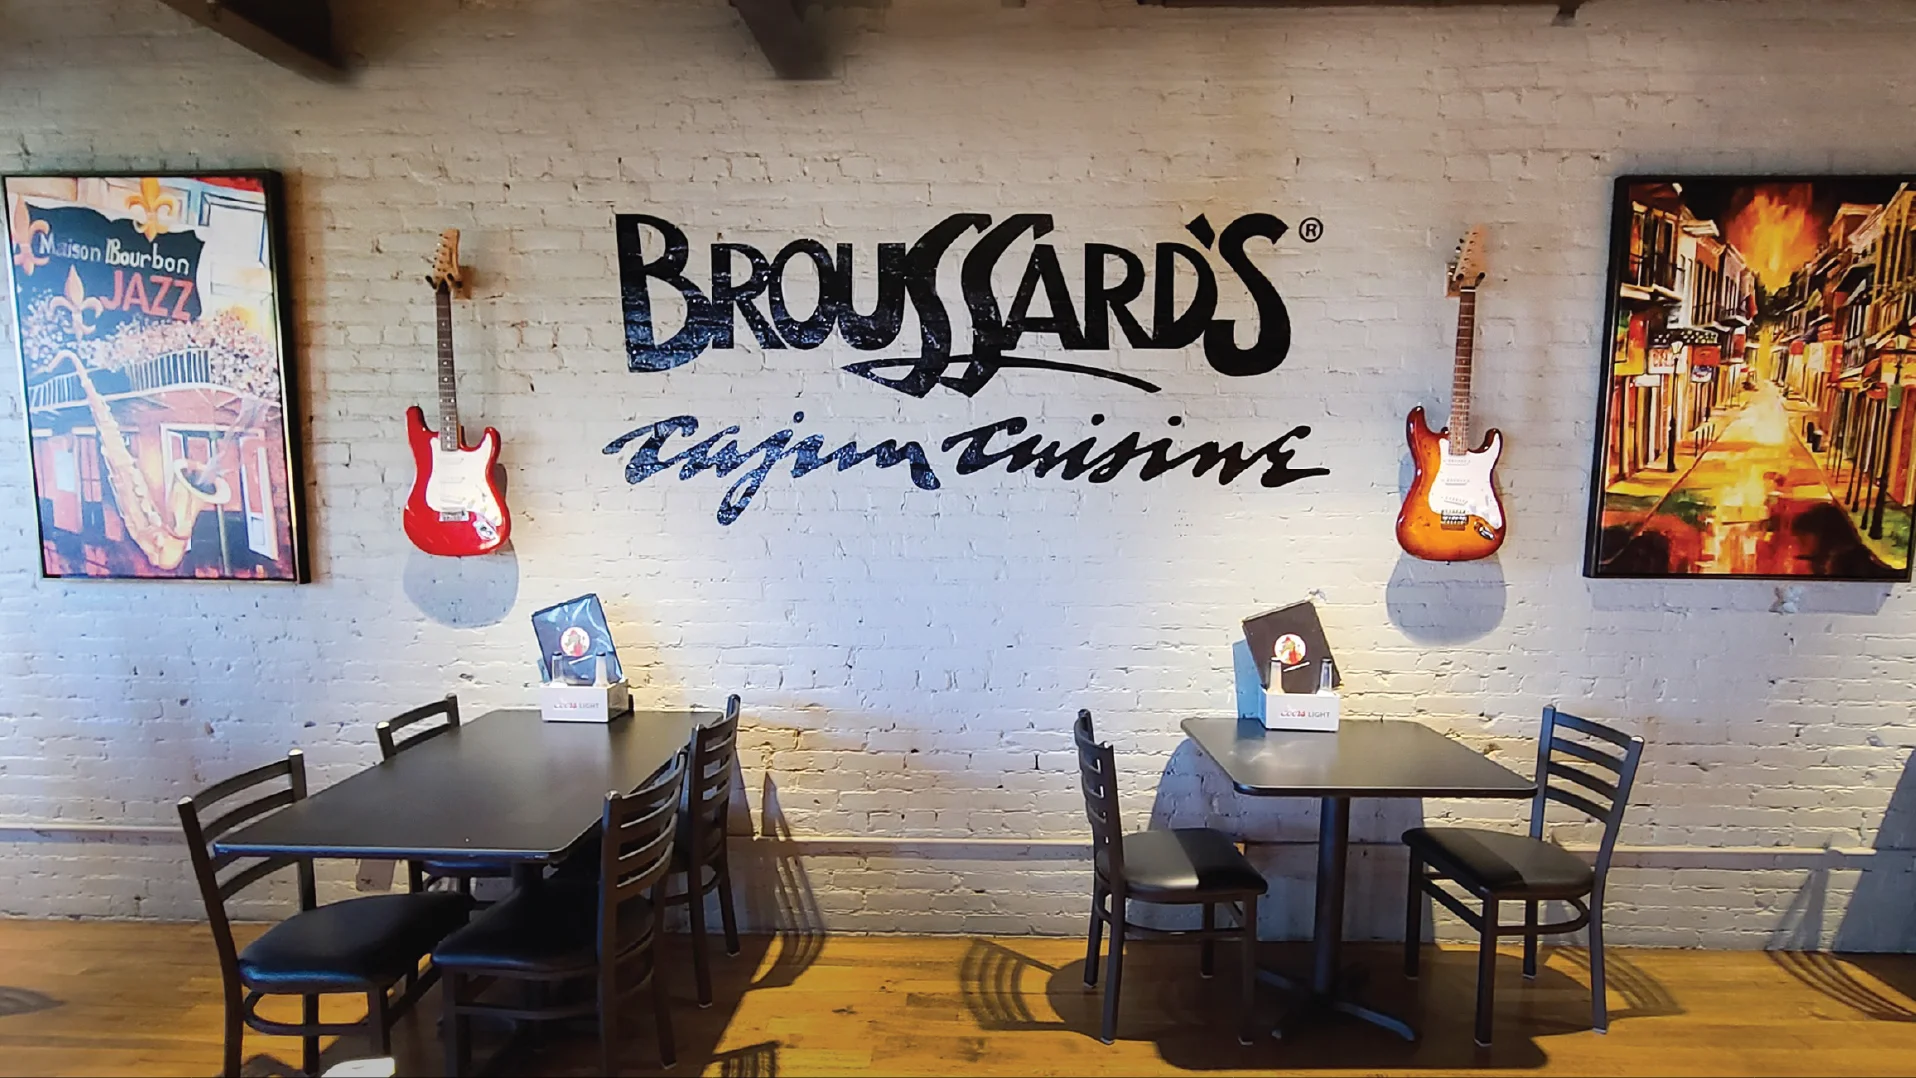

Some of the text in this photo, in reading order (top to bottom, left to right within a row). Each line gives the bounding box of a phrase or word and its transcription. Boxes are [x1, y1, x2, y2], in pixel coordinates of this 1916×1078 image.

[39, 232, 189, 275] Maison Bourbon
[101, 269, 194, 321] JAZZ
[616, 213, 1291, 398] BROUSSARD'S
[1308, 710, 1331, 718] LIGHT
